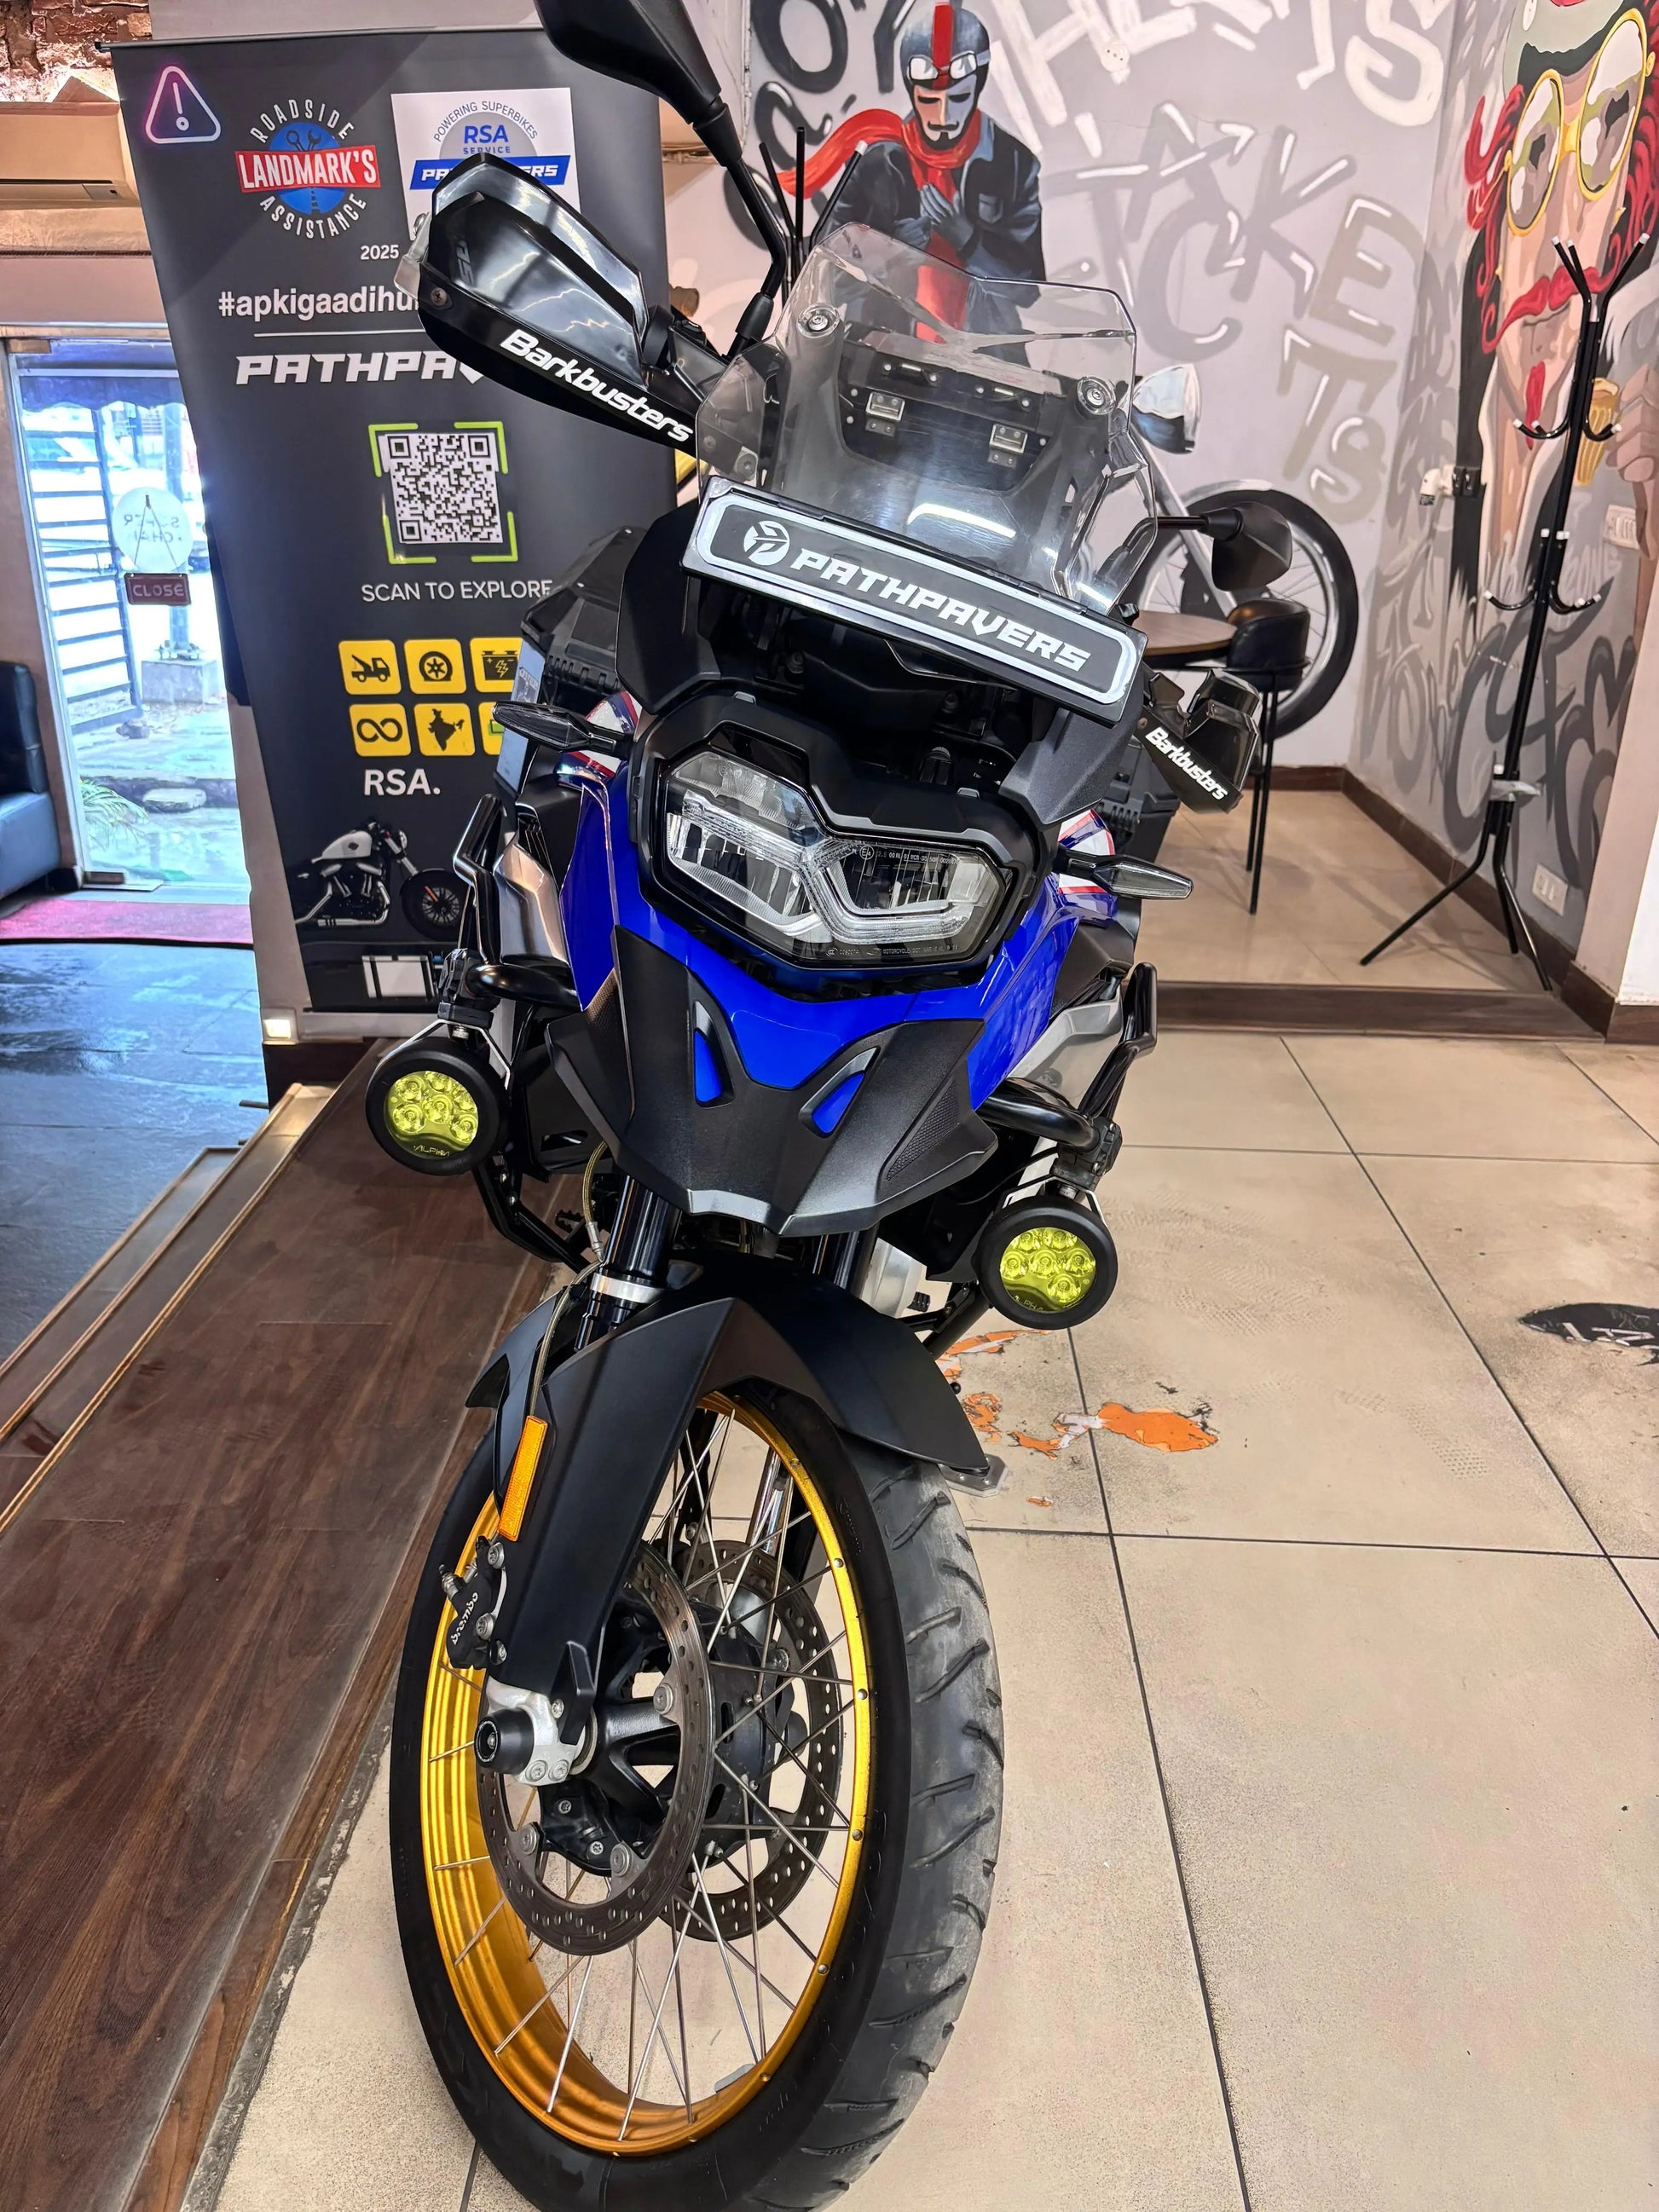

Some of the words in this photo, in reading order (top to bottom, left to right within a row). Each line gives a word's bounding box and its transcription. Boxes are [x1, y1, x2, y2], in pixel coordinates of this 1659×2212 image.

[250, 99, 355, 143] ROADSIDE
[433, 101, 478, 142] POWERING
[482, 101, 538, 140] SUPERBIKES
[463, 124, 509, 144] RSA
[239, 148, 377, 189] LANDMARK'S
[463, 146, 511, 155] SERVICE
[260, 193, 367, 239] ASSISTANCE
[360, 245, 400, 260] 2025
[500, 328, 694, 442] Barkbusters
[132, 584, 185, 597] CLOSE
[361, 582, 420, 603] SCAN
[425, 581, 455, 600] TO
[789, 547, 1091, 672] PATHPAVERS
[364, 768, 441, 796] RSA.
[1145, 726, 1228, 800] Barkbusters
[450, 1591, 479, 1646] brembo
